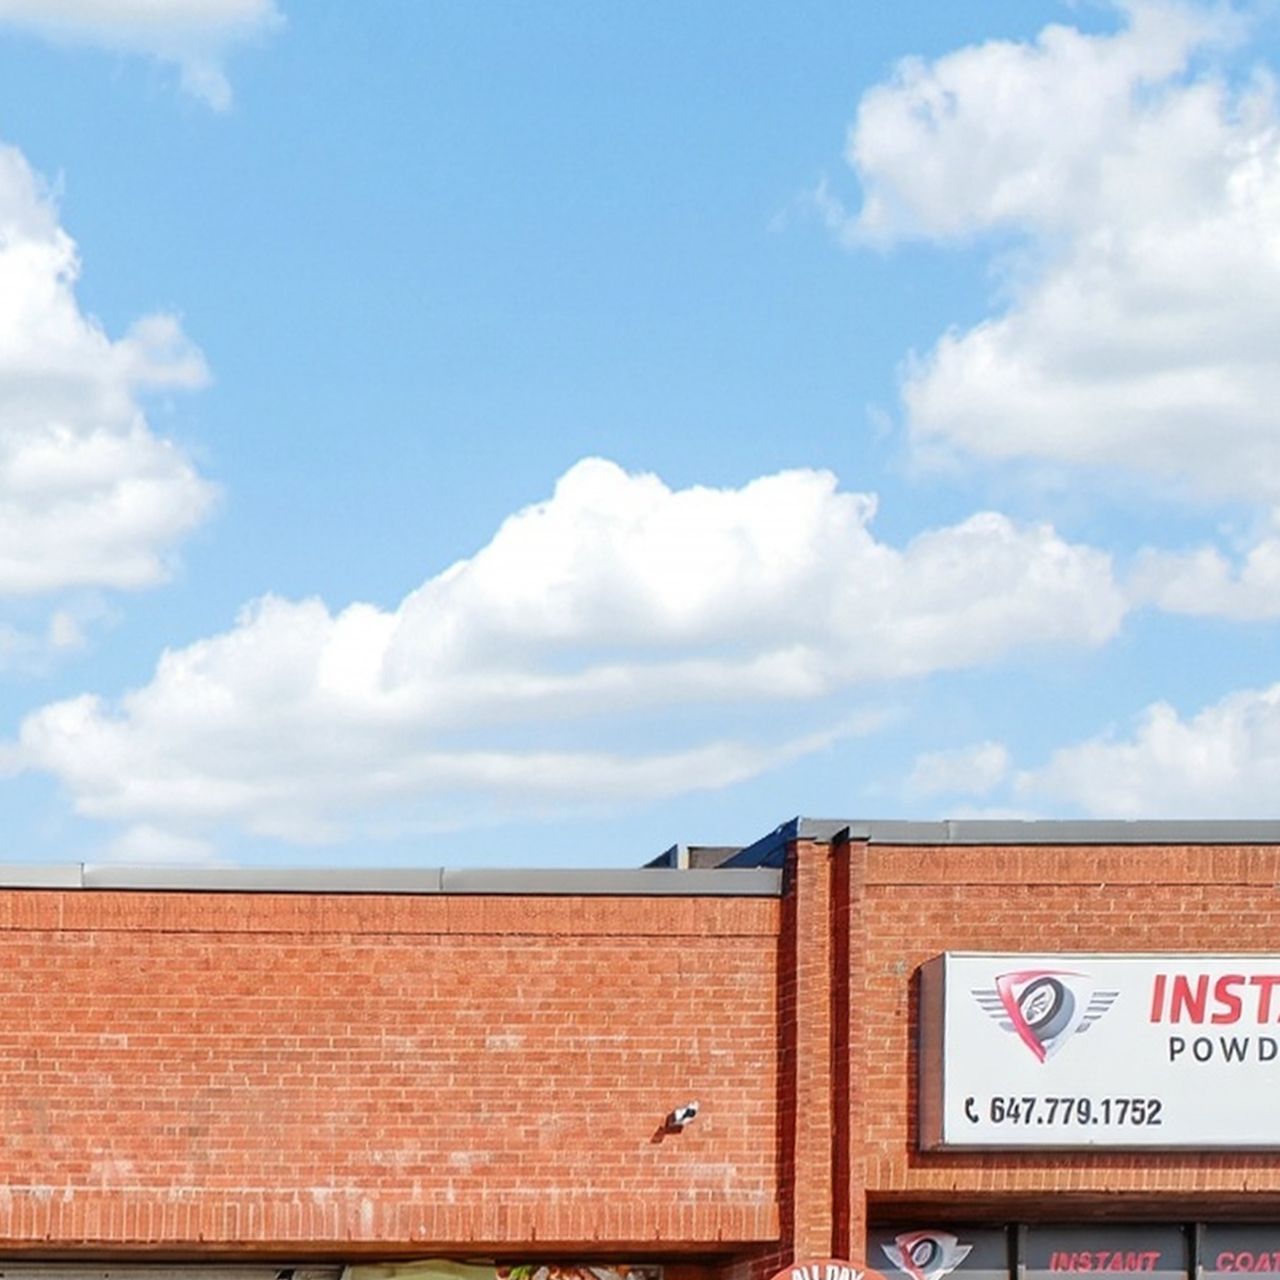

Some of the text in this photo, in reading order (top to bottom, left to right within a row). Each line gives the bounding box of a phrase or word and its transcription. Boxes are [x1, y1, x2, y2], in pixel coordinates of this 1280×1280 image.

[1150, 973, 1280, 1025] INST
[1169, 1035, 1279, 1063] POWD
[990, 1097, 1163, 1126] 647.779.1752
[1048, 1252, 1161, 1273] INSTANT
